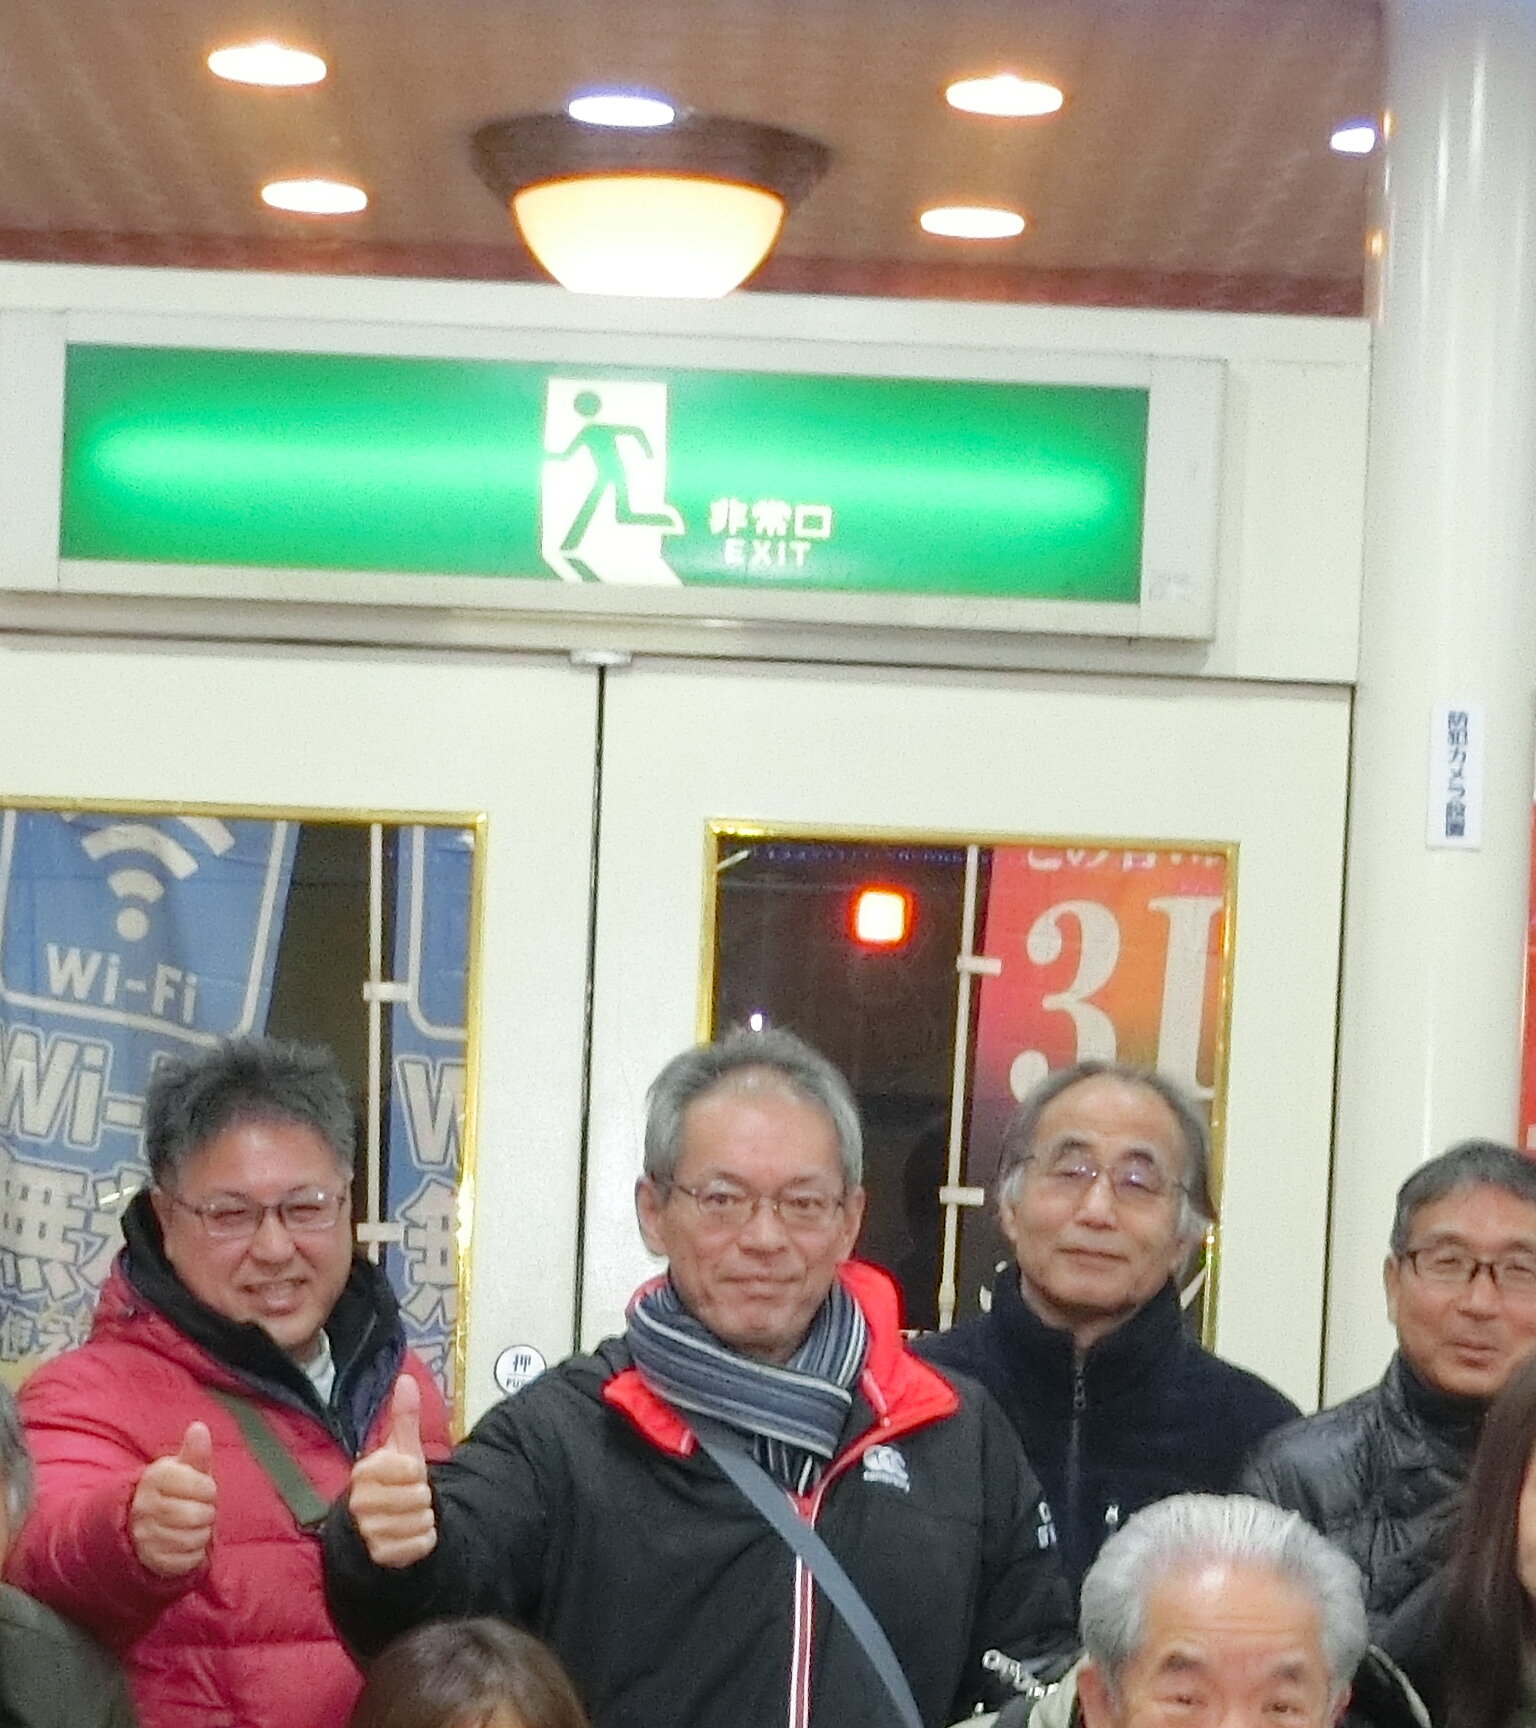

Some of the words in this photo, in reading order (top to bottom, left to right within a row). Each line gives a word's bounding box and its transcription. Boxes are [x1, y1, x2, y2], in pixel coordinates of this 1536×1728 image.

[710, 497, 833, 540] 非常口
[724, 539, 811, 568] EXIT
[46, 941, 198, 1026] Wi-Fi
